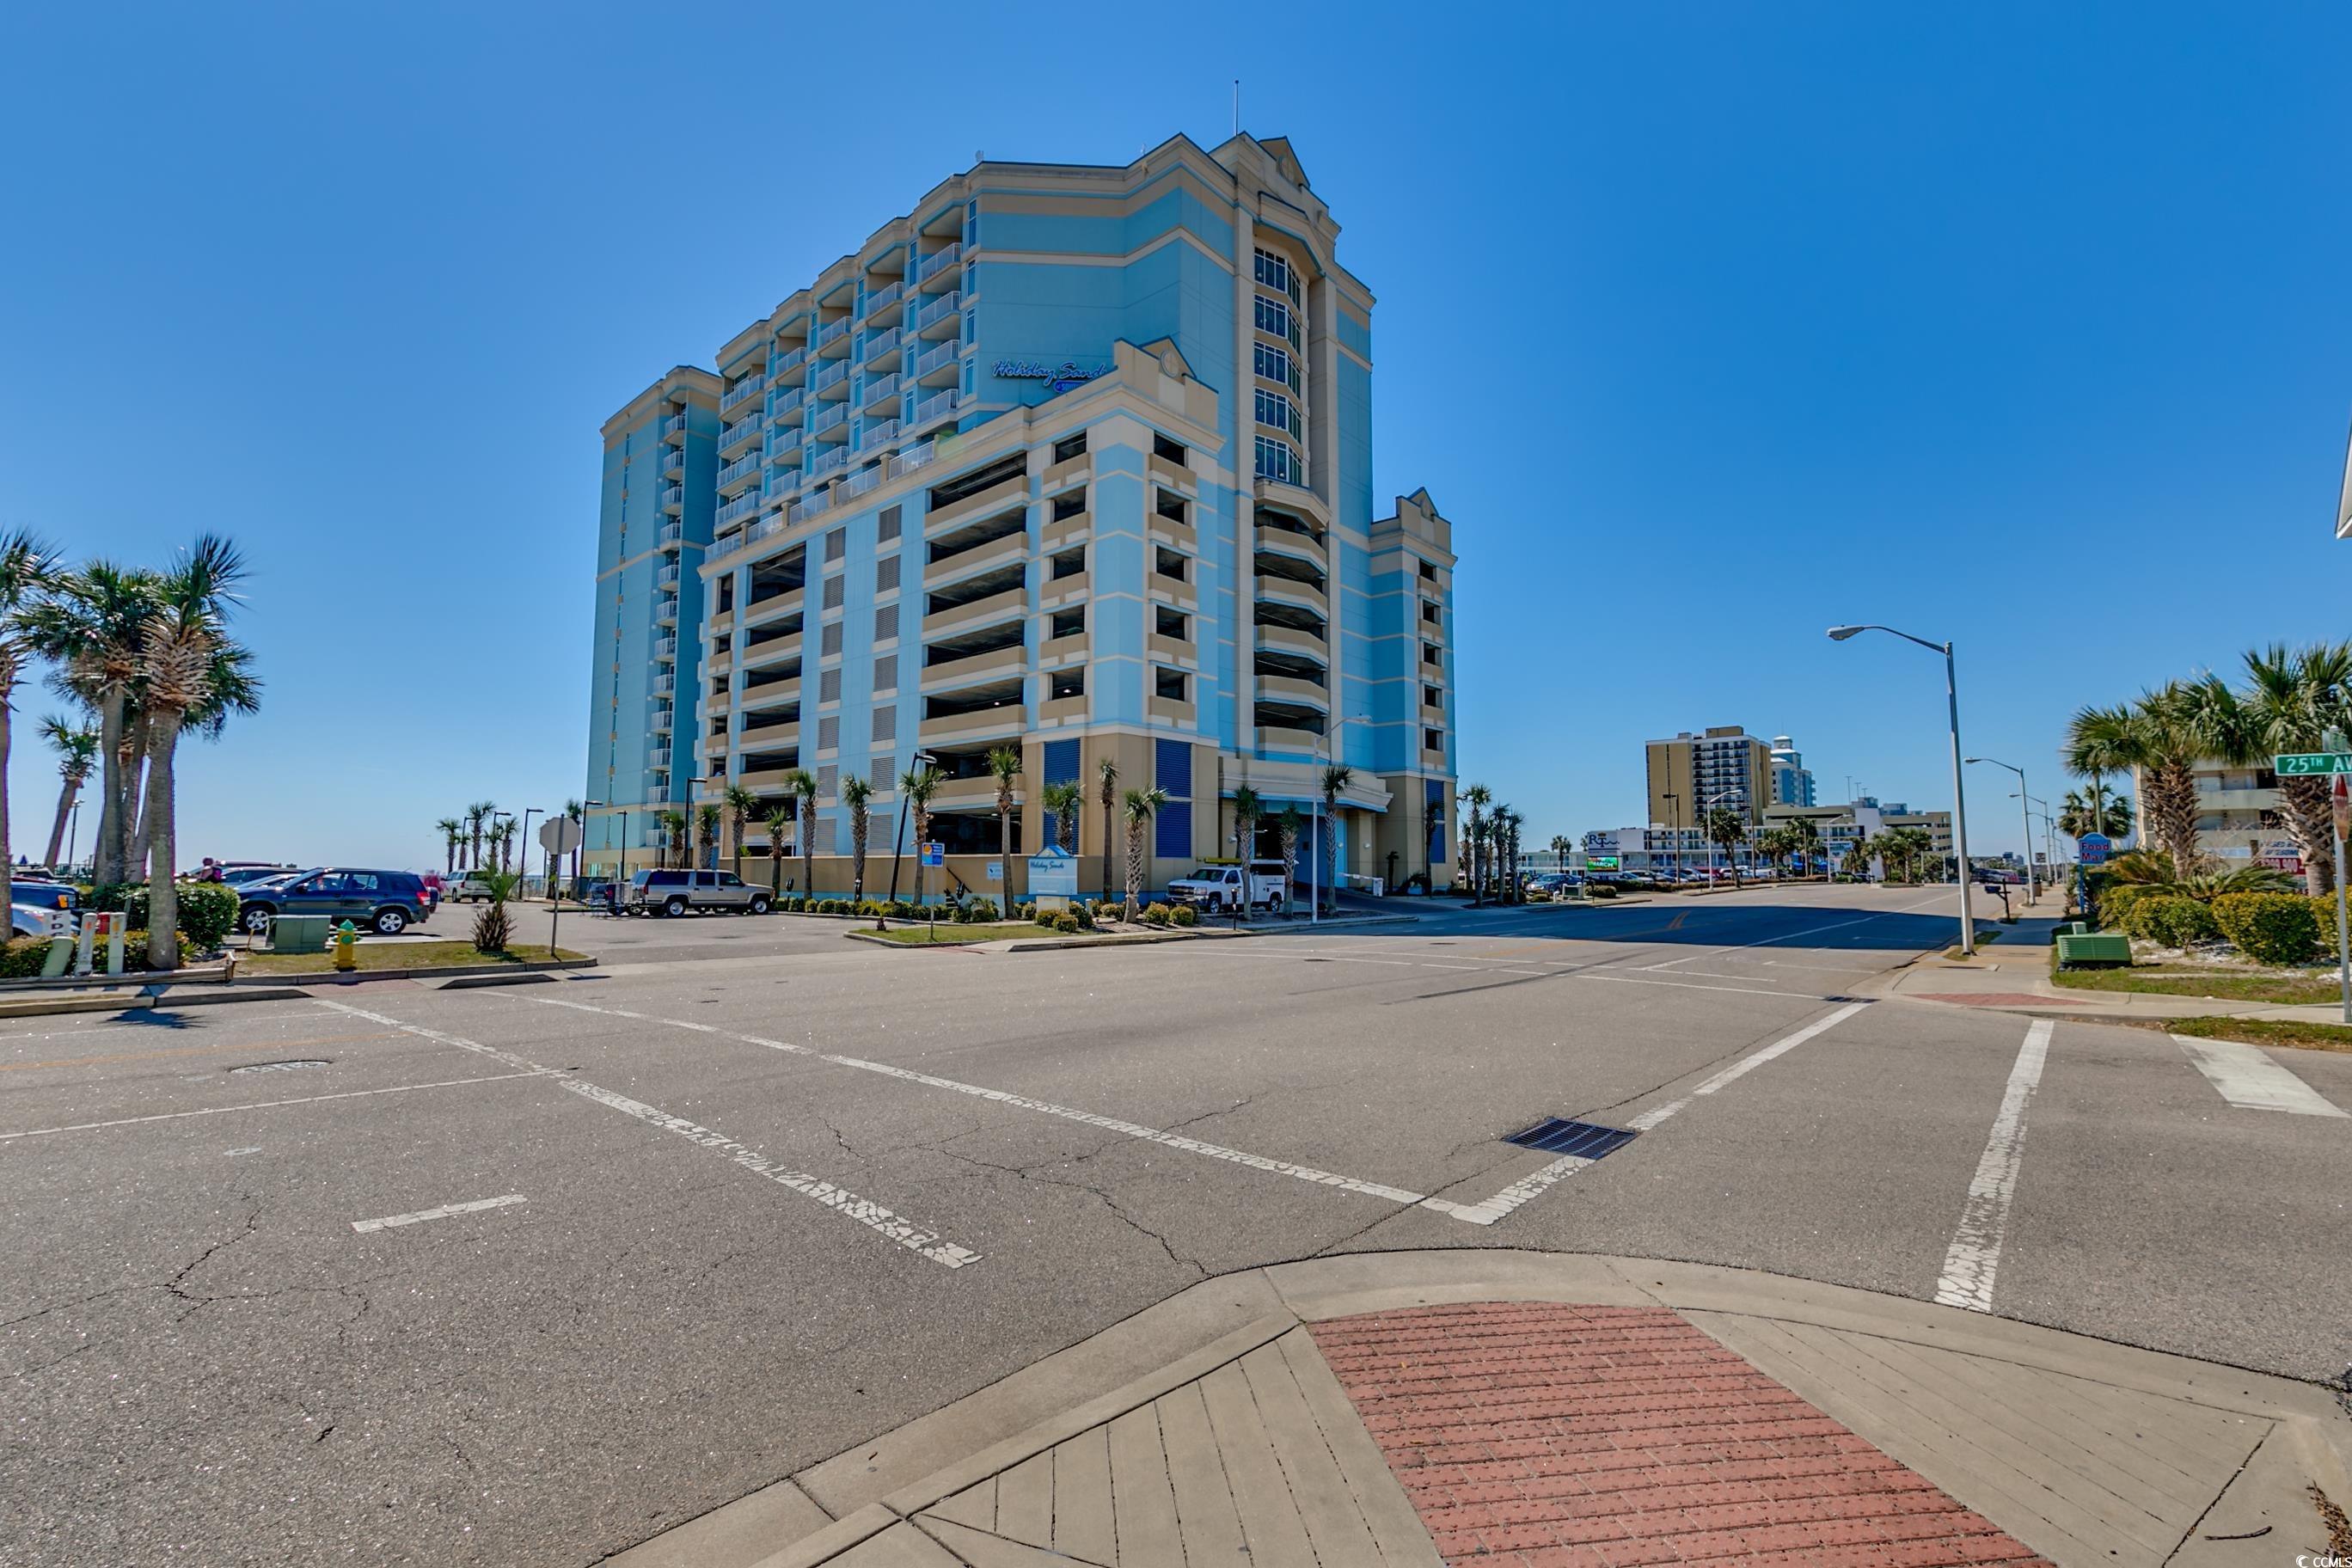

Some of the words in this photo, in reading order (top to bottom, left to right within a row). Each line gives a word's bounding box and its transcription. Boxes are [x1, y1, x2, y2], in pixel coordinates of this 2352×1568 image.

[993, 360, 1056, 386] Holiday
[1059, 361, 1106, 379] Sand
[2287, 757, 2324, 773] 25TH
[2081, 842, 2110, 851] Food
[2081, 852, 2104, 861] Mar
